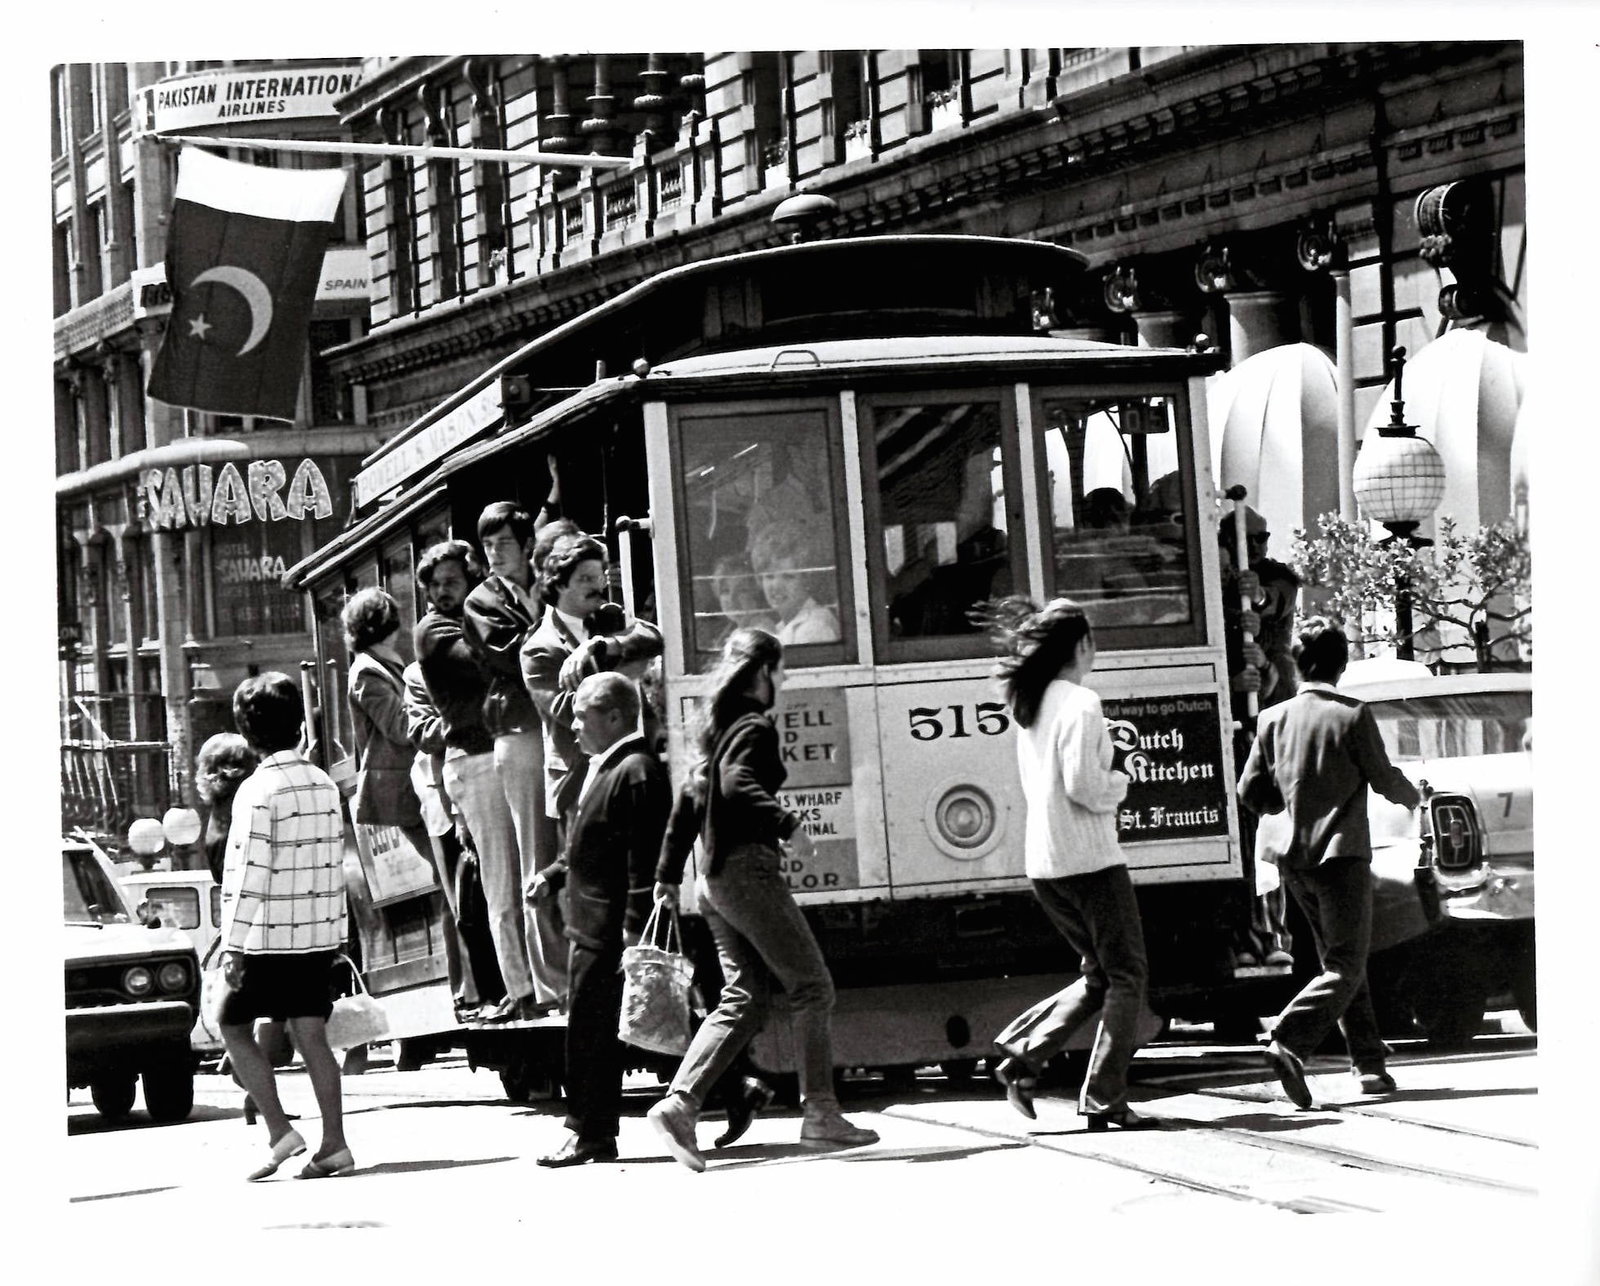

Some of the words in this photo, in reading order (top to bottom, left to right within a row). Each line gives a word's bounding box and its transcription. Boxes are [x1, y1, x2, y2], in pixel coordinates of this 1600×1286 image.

[158, 84, 216, 110] PAKISTAN
[218, 100, 285, 117] AIRLINES
[325, 278, 367, 290] SPAIN
[1146, 703, 1158, 714] to
[1160, 704, 1175, 716] go
[1177, 700, 1212, 713] Dutch
[908, 702, 1010, 741] 515
[1103, 718, 1184, 752] Dutch
[782, 743, 834, 762] KET
[1124, 751, 1214, 784] Kitchen
[795, 792, 842, 806] WHARF
[1497, 792, 1513, 818] 7
[1118, 809, 1146, 830] St.
[1149, 806, 1219, 828] Francis
[787, 873, 839, 889] LOR
